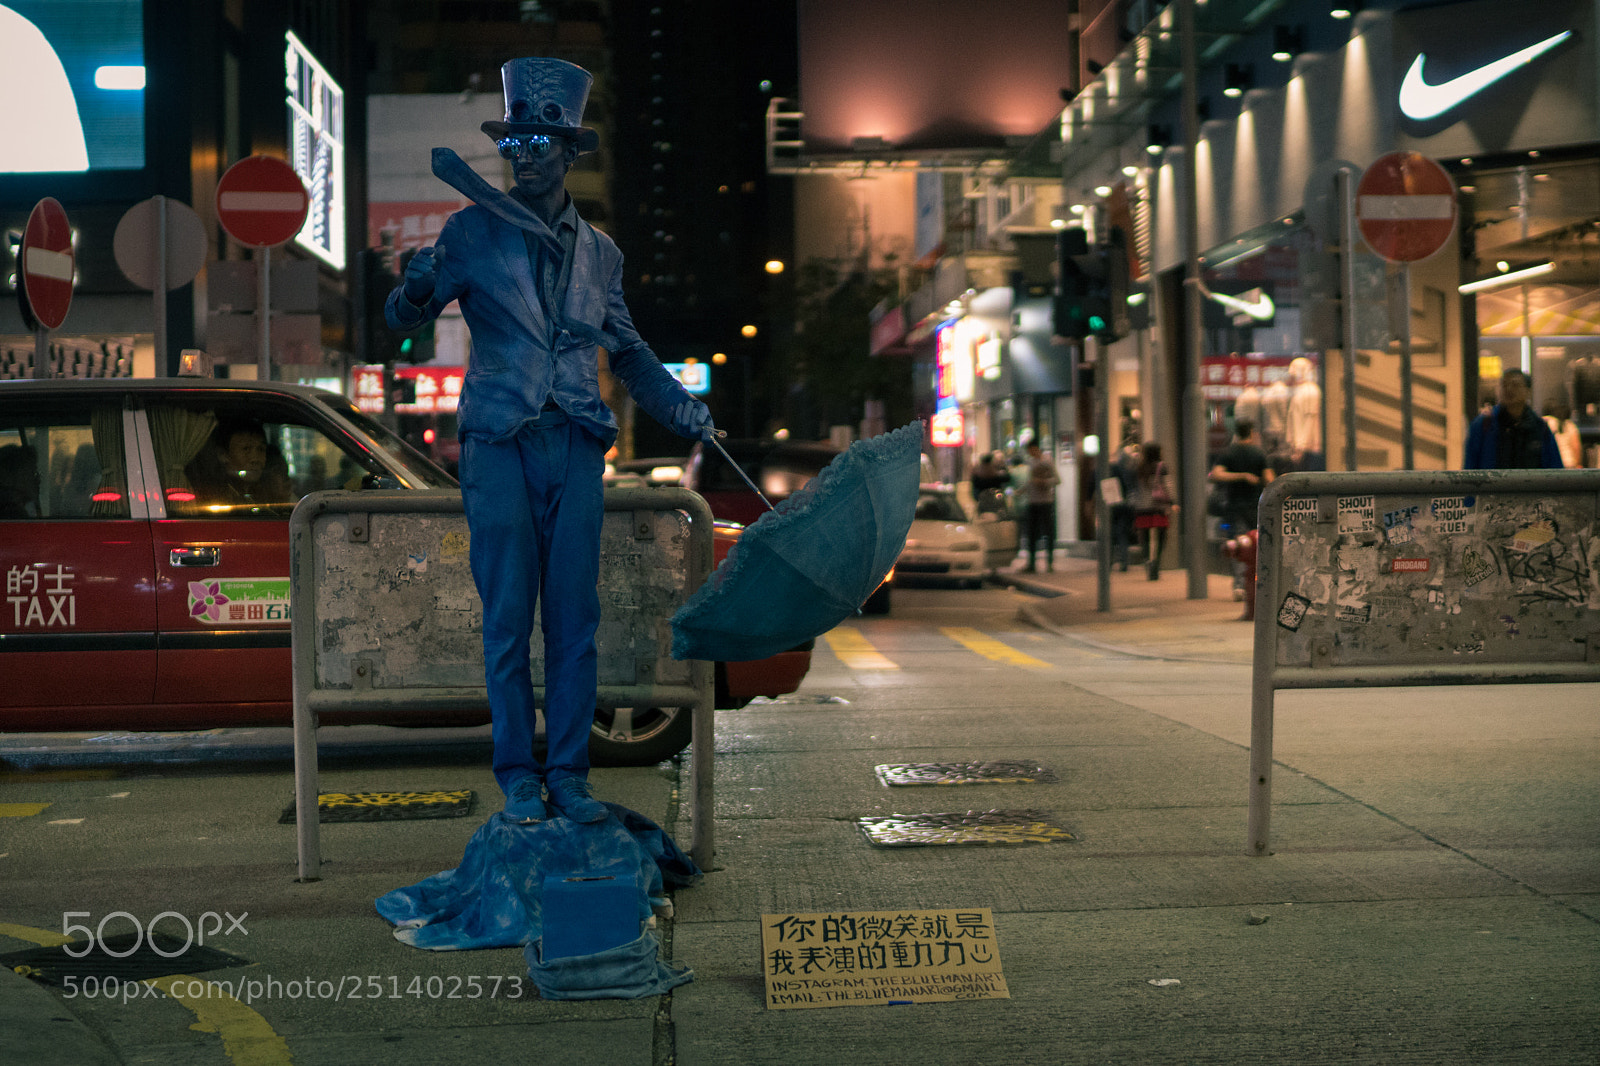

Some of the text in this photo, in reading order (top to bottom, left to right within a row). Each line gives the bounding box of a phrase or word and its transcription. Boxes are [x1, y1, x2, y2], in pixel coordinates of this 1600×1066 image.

[1283, 500, 1318, 511] SHOUT
[1339, 498, 1373, 509] SHOUT
[7, 565, 75, 594] 的士
[7, 595, 76, 626] TAXI
[769, 914, 989, 943] 你的微笑就是
[768, 941, 966, 975] 我表演的動力
